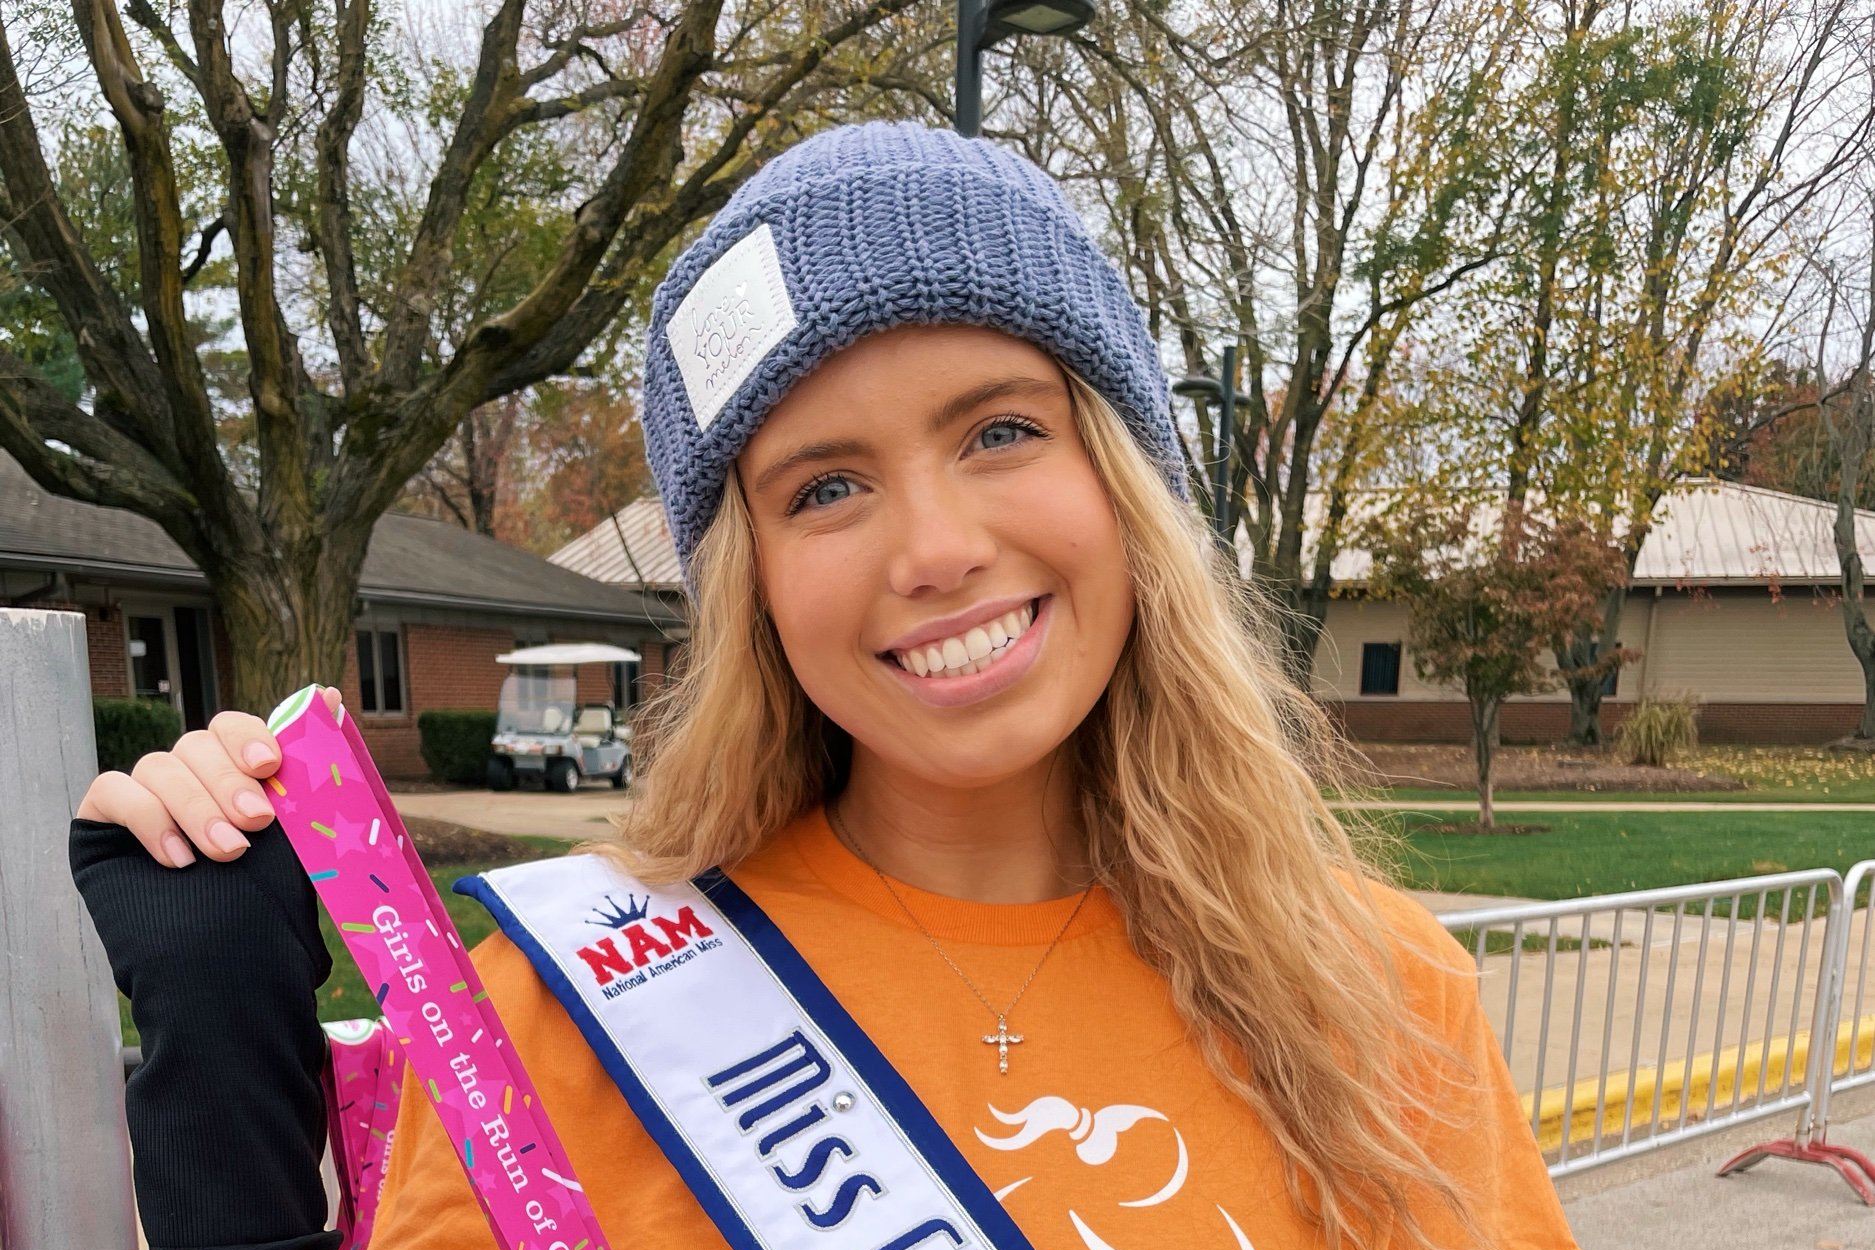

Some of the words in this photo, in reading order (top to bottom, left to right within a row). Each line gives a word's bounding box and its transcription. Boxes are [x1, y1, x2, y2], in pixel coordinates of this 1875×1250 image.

[697, 299, 755, 370] YOUR
[576, 905, 714, 986] NAM
[602, 970, 648, 1000] National
[648, 948, 697, 980] American
[695, 937, 723, 954] Miss
[372, 905, 428, 994] Girls
[421, 1001, 454, 1048] on
[449, 1052, 487, 1110] the
[480, 1114, 529, 1194] Run
[525, 1200, 558, 1235] of
[700, 1026, 889, 1232] Miss
